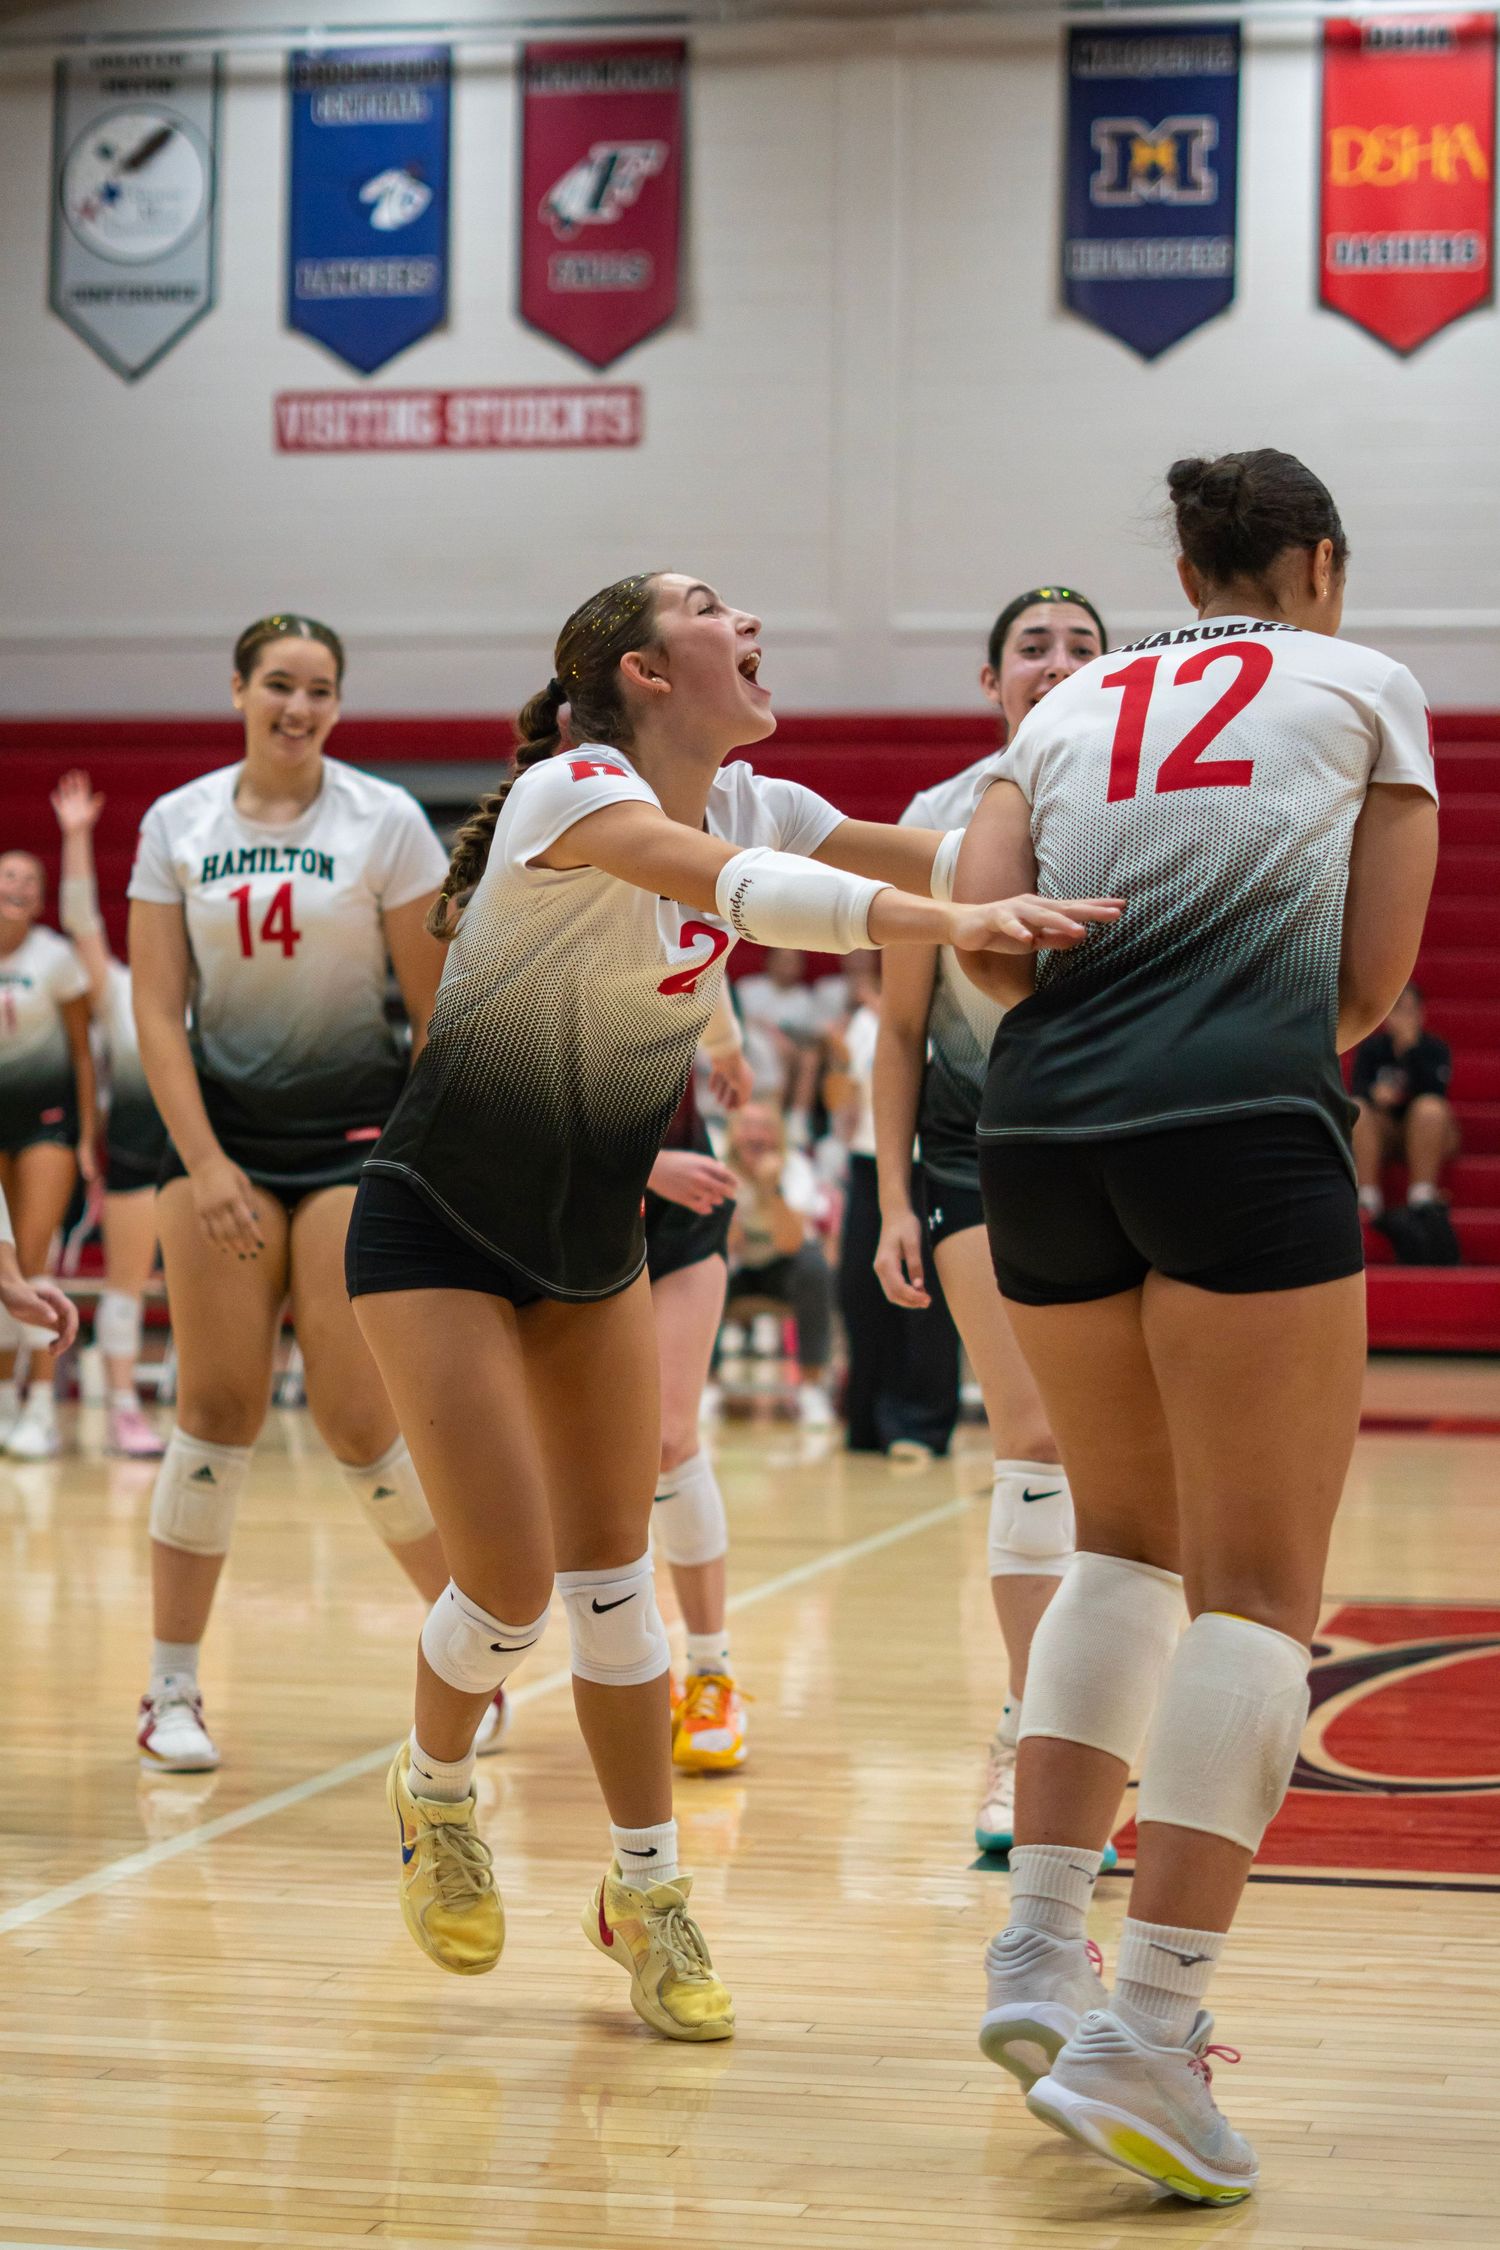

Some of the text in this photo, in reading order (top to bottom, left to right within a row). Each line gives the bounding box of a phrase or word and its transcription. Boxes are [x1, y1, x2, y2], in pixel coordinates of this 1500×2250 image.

[1330, 122, 1488, 186] DSHA
[276, 393, 633, 445] VISITING STUDENTS
[1101, 640, 1274, 803] 12
[201, 847, 334, 884] HAMILTON
[228, 881, 302, 958] 14
[657, 920, 729, 995] 2
